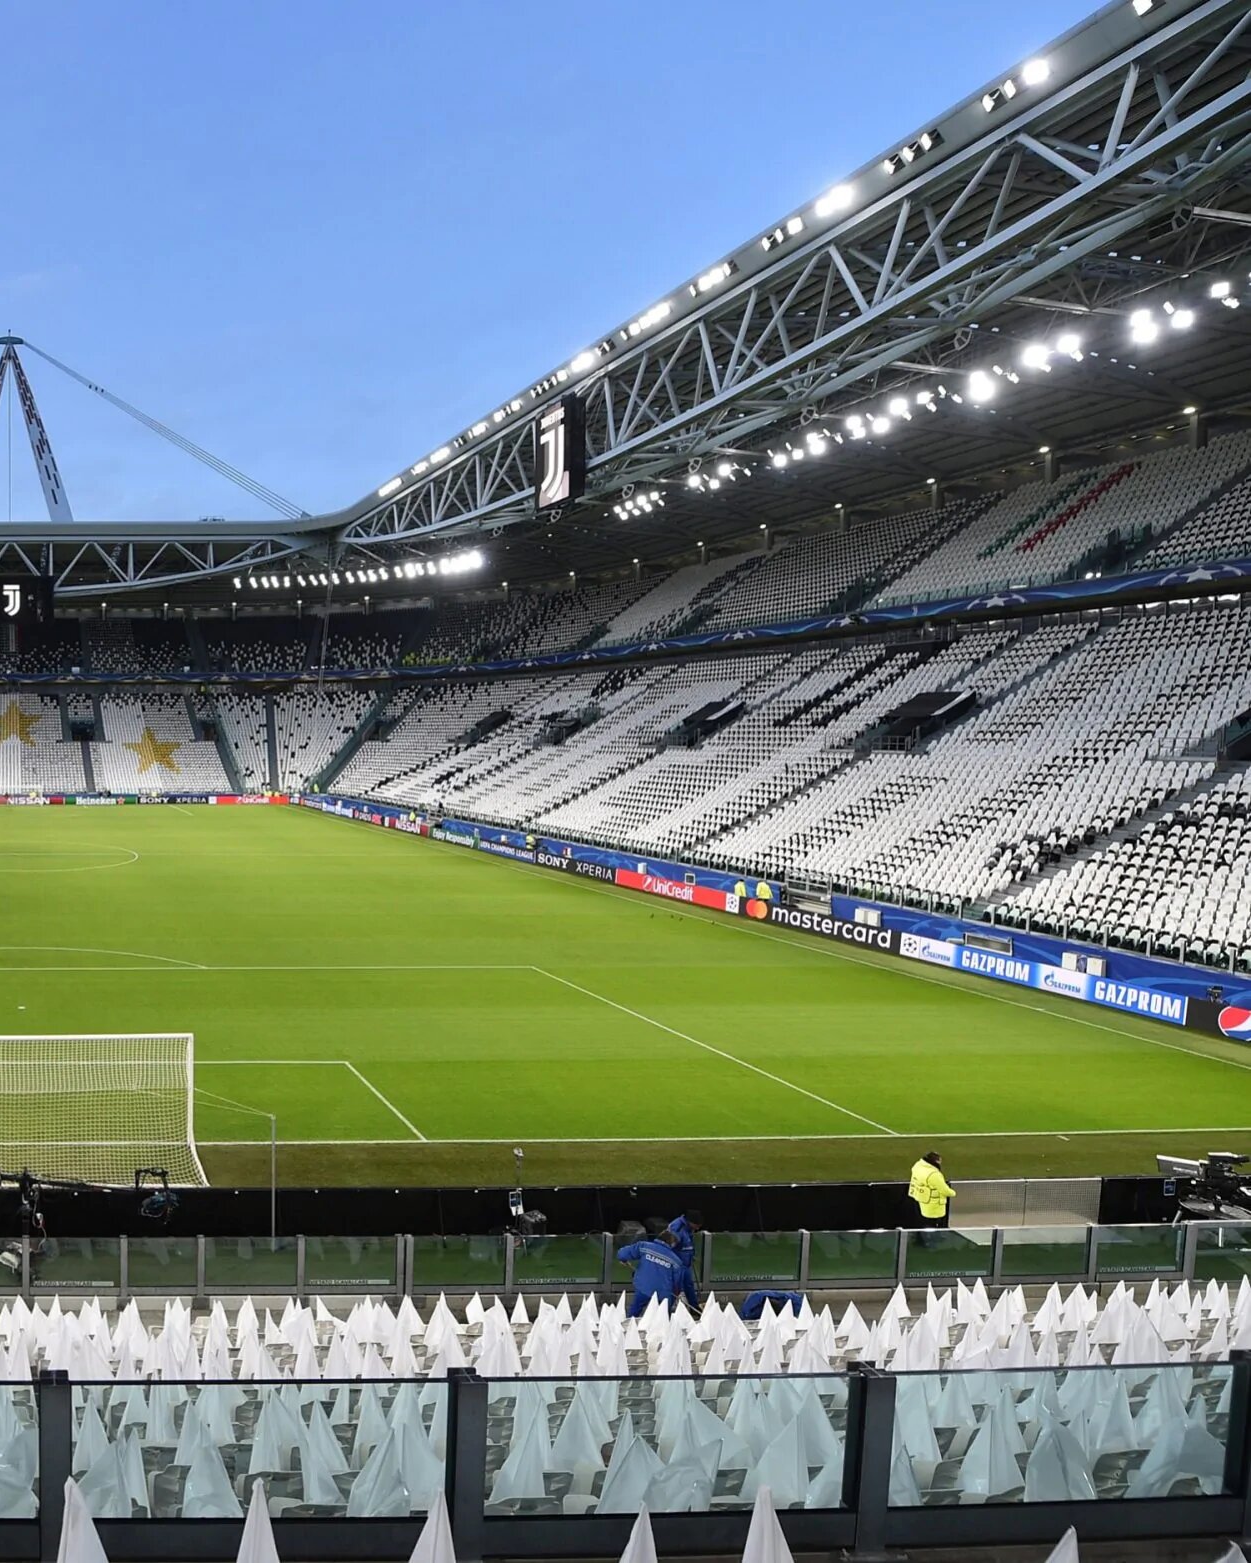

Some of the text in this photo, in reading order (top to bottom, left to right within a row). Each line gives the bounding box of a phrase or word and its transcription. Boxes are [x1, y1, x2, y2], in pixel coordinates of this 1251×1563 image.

[7, 796, 50, 805] NISSAN
[76, 796, 116, 805] Heineken
[140, 796, 170, 804] SONY
[395, 818, 421, 834] NISSAN
[432, 828, 475, 849] Enjoy Responsibly
[479, 840, 534, 860] UEFA CHAMPIONS LEAGUE
[537, 853, 613, 881] SONY XPERIA
[652, 878, 695, 902] UniCredit
[771, 906, 892, 949] mastercard
[961, 950, 1030, 982] GAZPROM
[1053, 983, 1082, 994] GAZPROM
[1094, 980, 1182, 1020] GAZPROM
